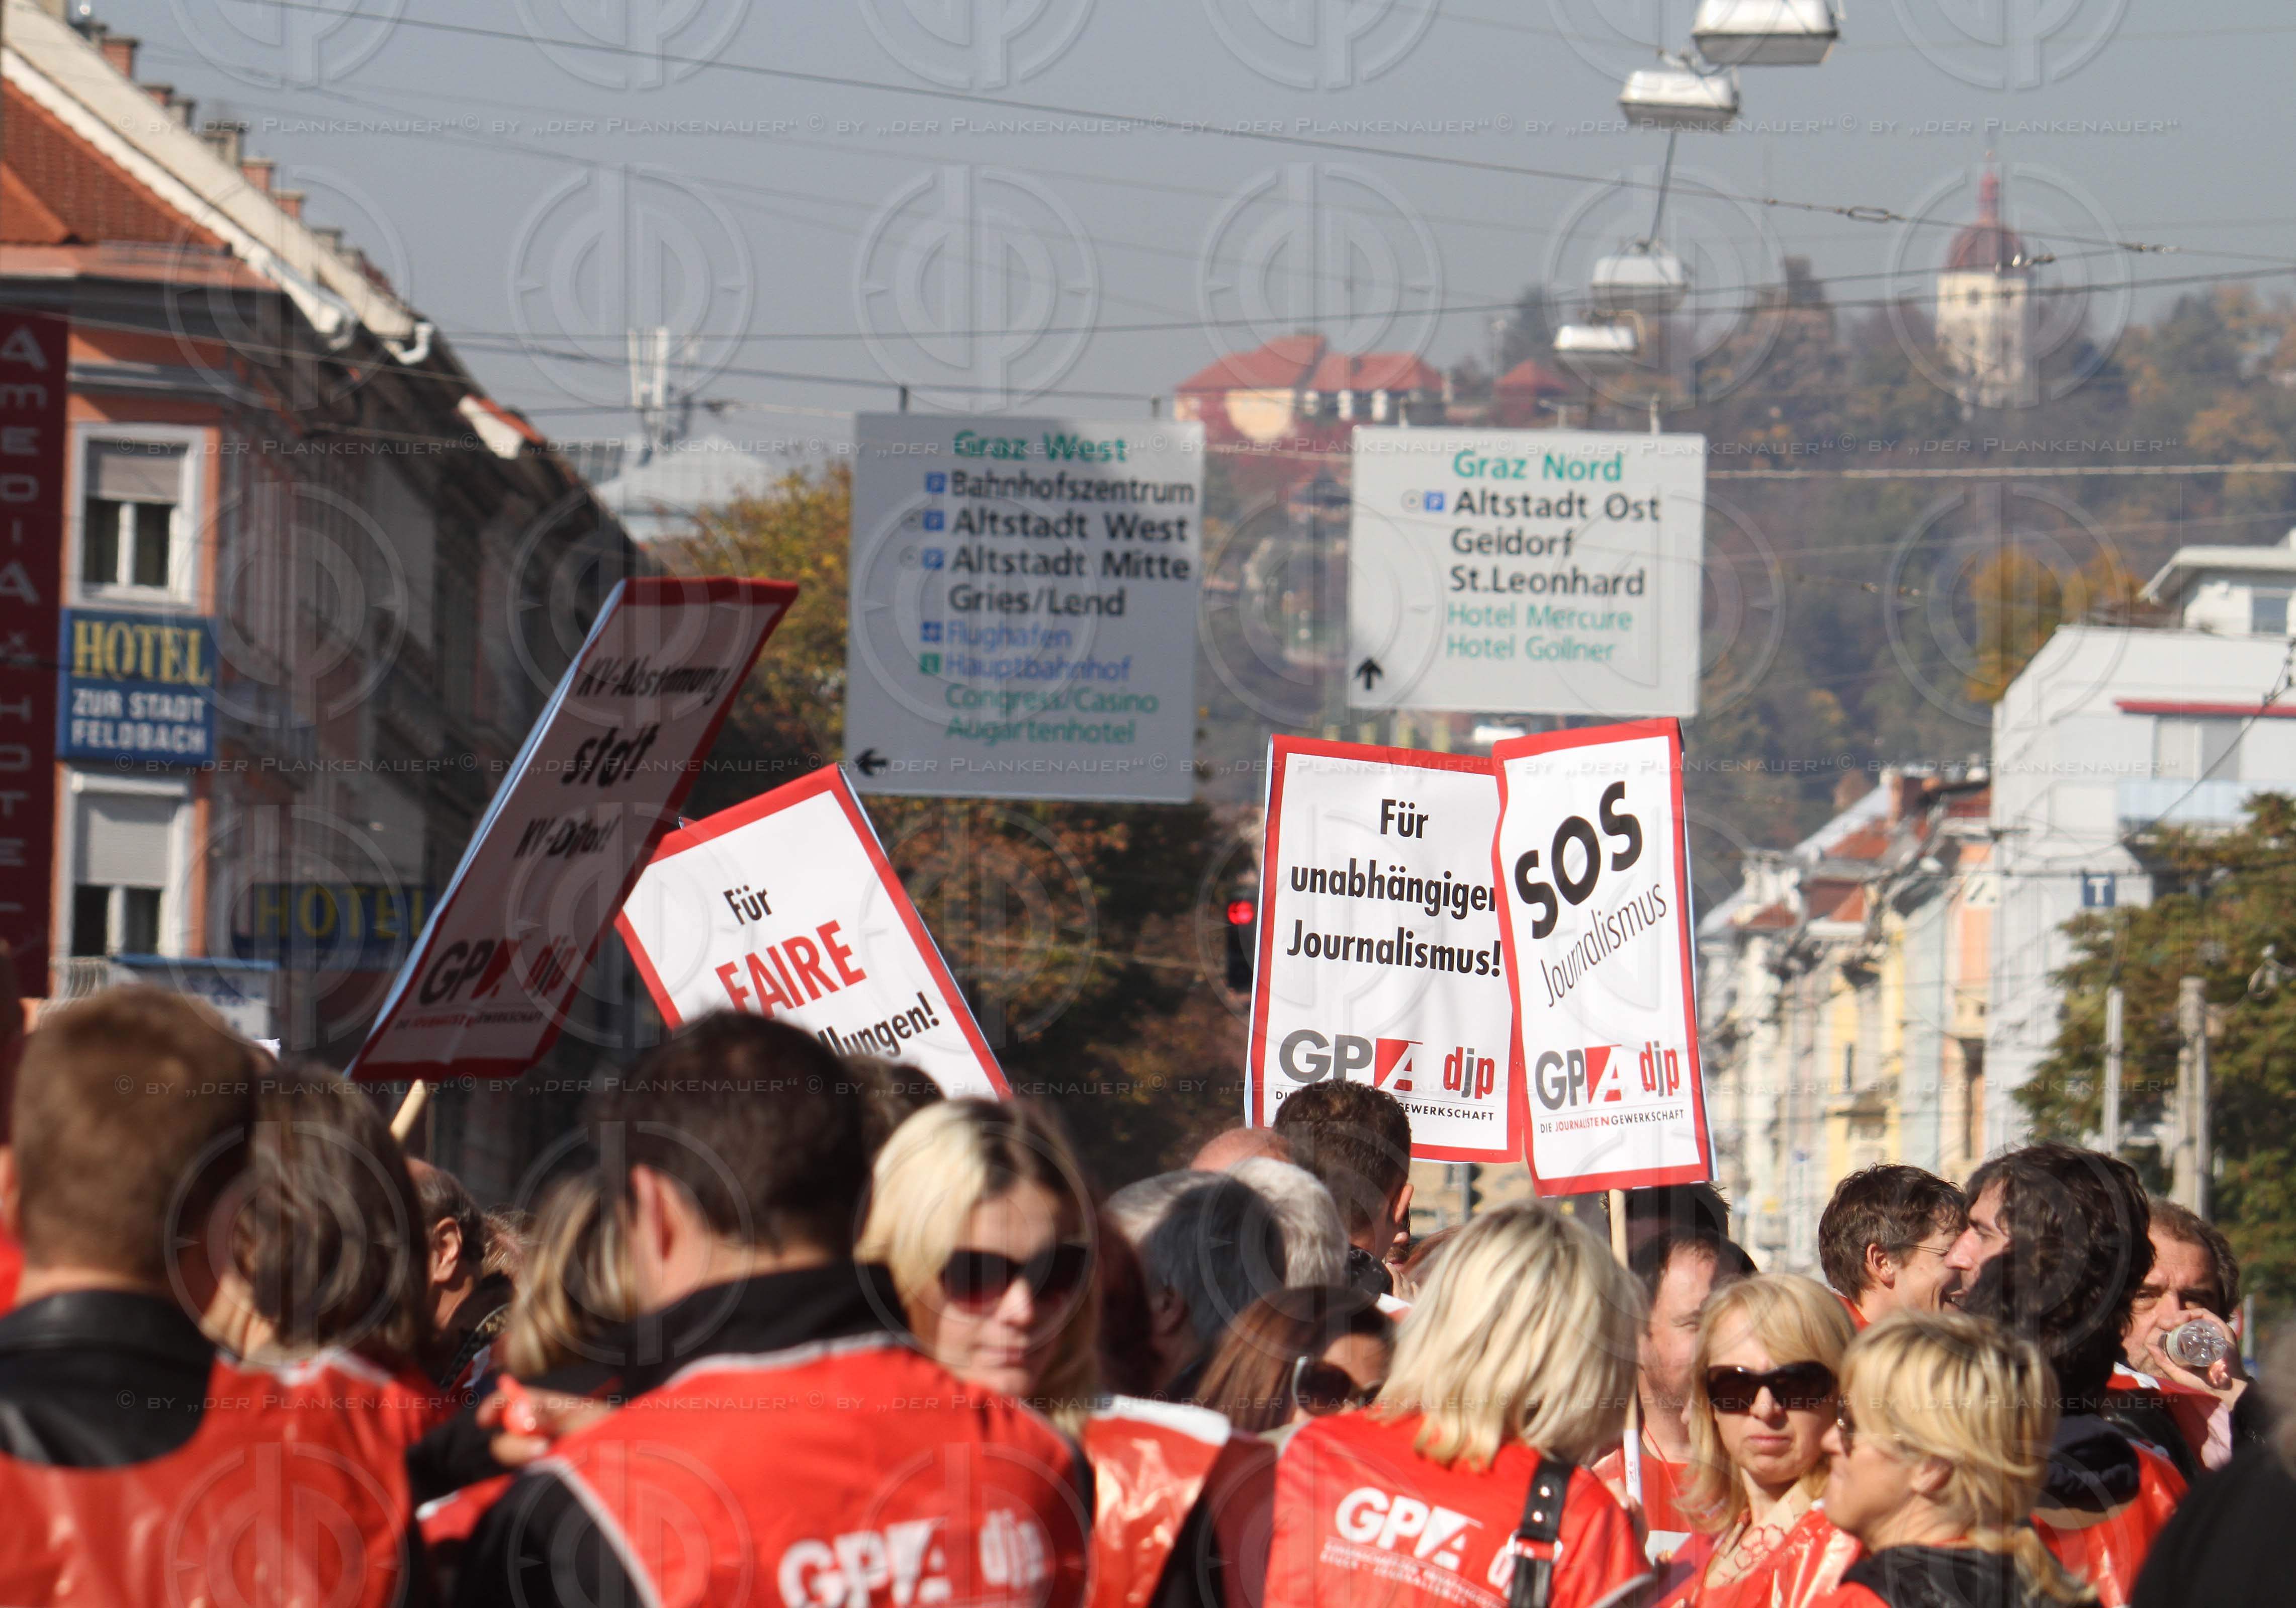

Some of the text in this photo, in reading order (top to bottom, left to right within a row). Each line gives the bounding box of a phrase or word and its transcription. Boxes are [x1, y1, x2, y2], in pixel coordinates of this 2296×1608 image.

[953, 430, 1126, 462] Graz West
[1453, 451, 1623, 482] Graz Nord
[951, 470, 1195, 504] Bahnhofszentrum
[1453, 489, 1661, 521] Altstadt Ost
[951, 506, 1188, 542] Altstadt West
[1450, 527, 1576, 557] Geidorf
[950, 545, 1190, 581] Altstadt Mitte
[1449, 565, 1645, 596] St.Leonhard
[949, 584, 1125, 616] Gries/Lend
[1447, 602, 1633, 631] Hotel Mercure
[946, 620, 1073, 650] Flughafen
[1446, 635, 1616, 662] Hotel Gollner
[72, 620, 211, 686] HOTEL
[945, 655, 1132, 682] Hauptbahnhof
[72, 687, 205, 723] ZUR STADT
[945, 683, 1160, 716] Congress/Casino
[71, 718, 207, 754] FELDBACH
[945, 717, 1135, 747] Augartenhotel
[1380, 798, 1429, 839] Für
[1514, 781, 1643, 940] SOS
[723, 884, 773, 926] Für
[1287, 920, 1501, 977] Journalismus!
[1541, 883, 1667, 1008] Journalismus
[714, 920, 868, 1020] FAIRE
[1279, 1029, 1495, 1100] GPA djp
[1535, 1040, 1680, 1111] GPA djp
[1540, 1109, 1685, 1134] DIE JOURNALISTENGEWERKSCHAFT
[1335, 1486, 1483, 1570] GPA
